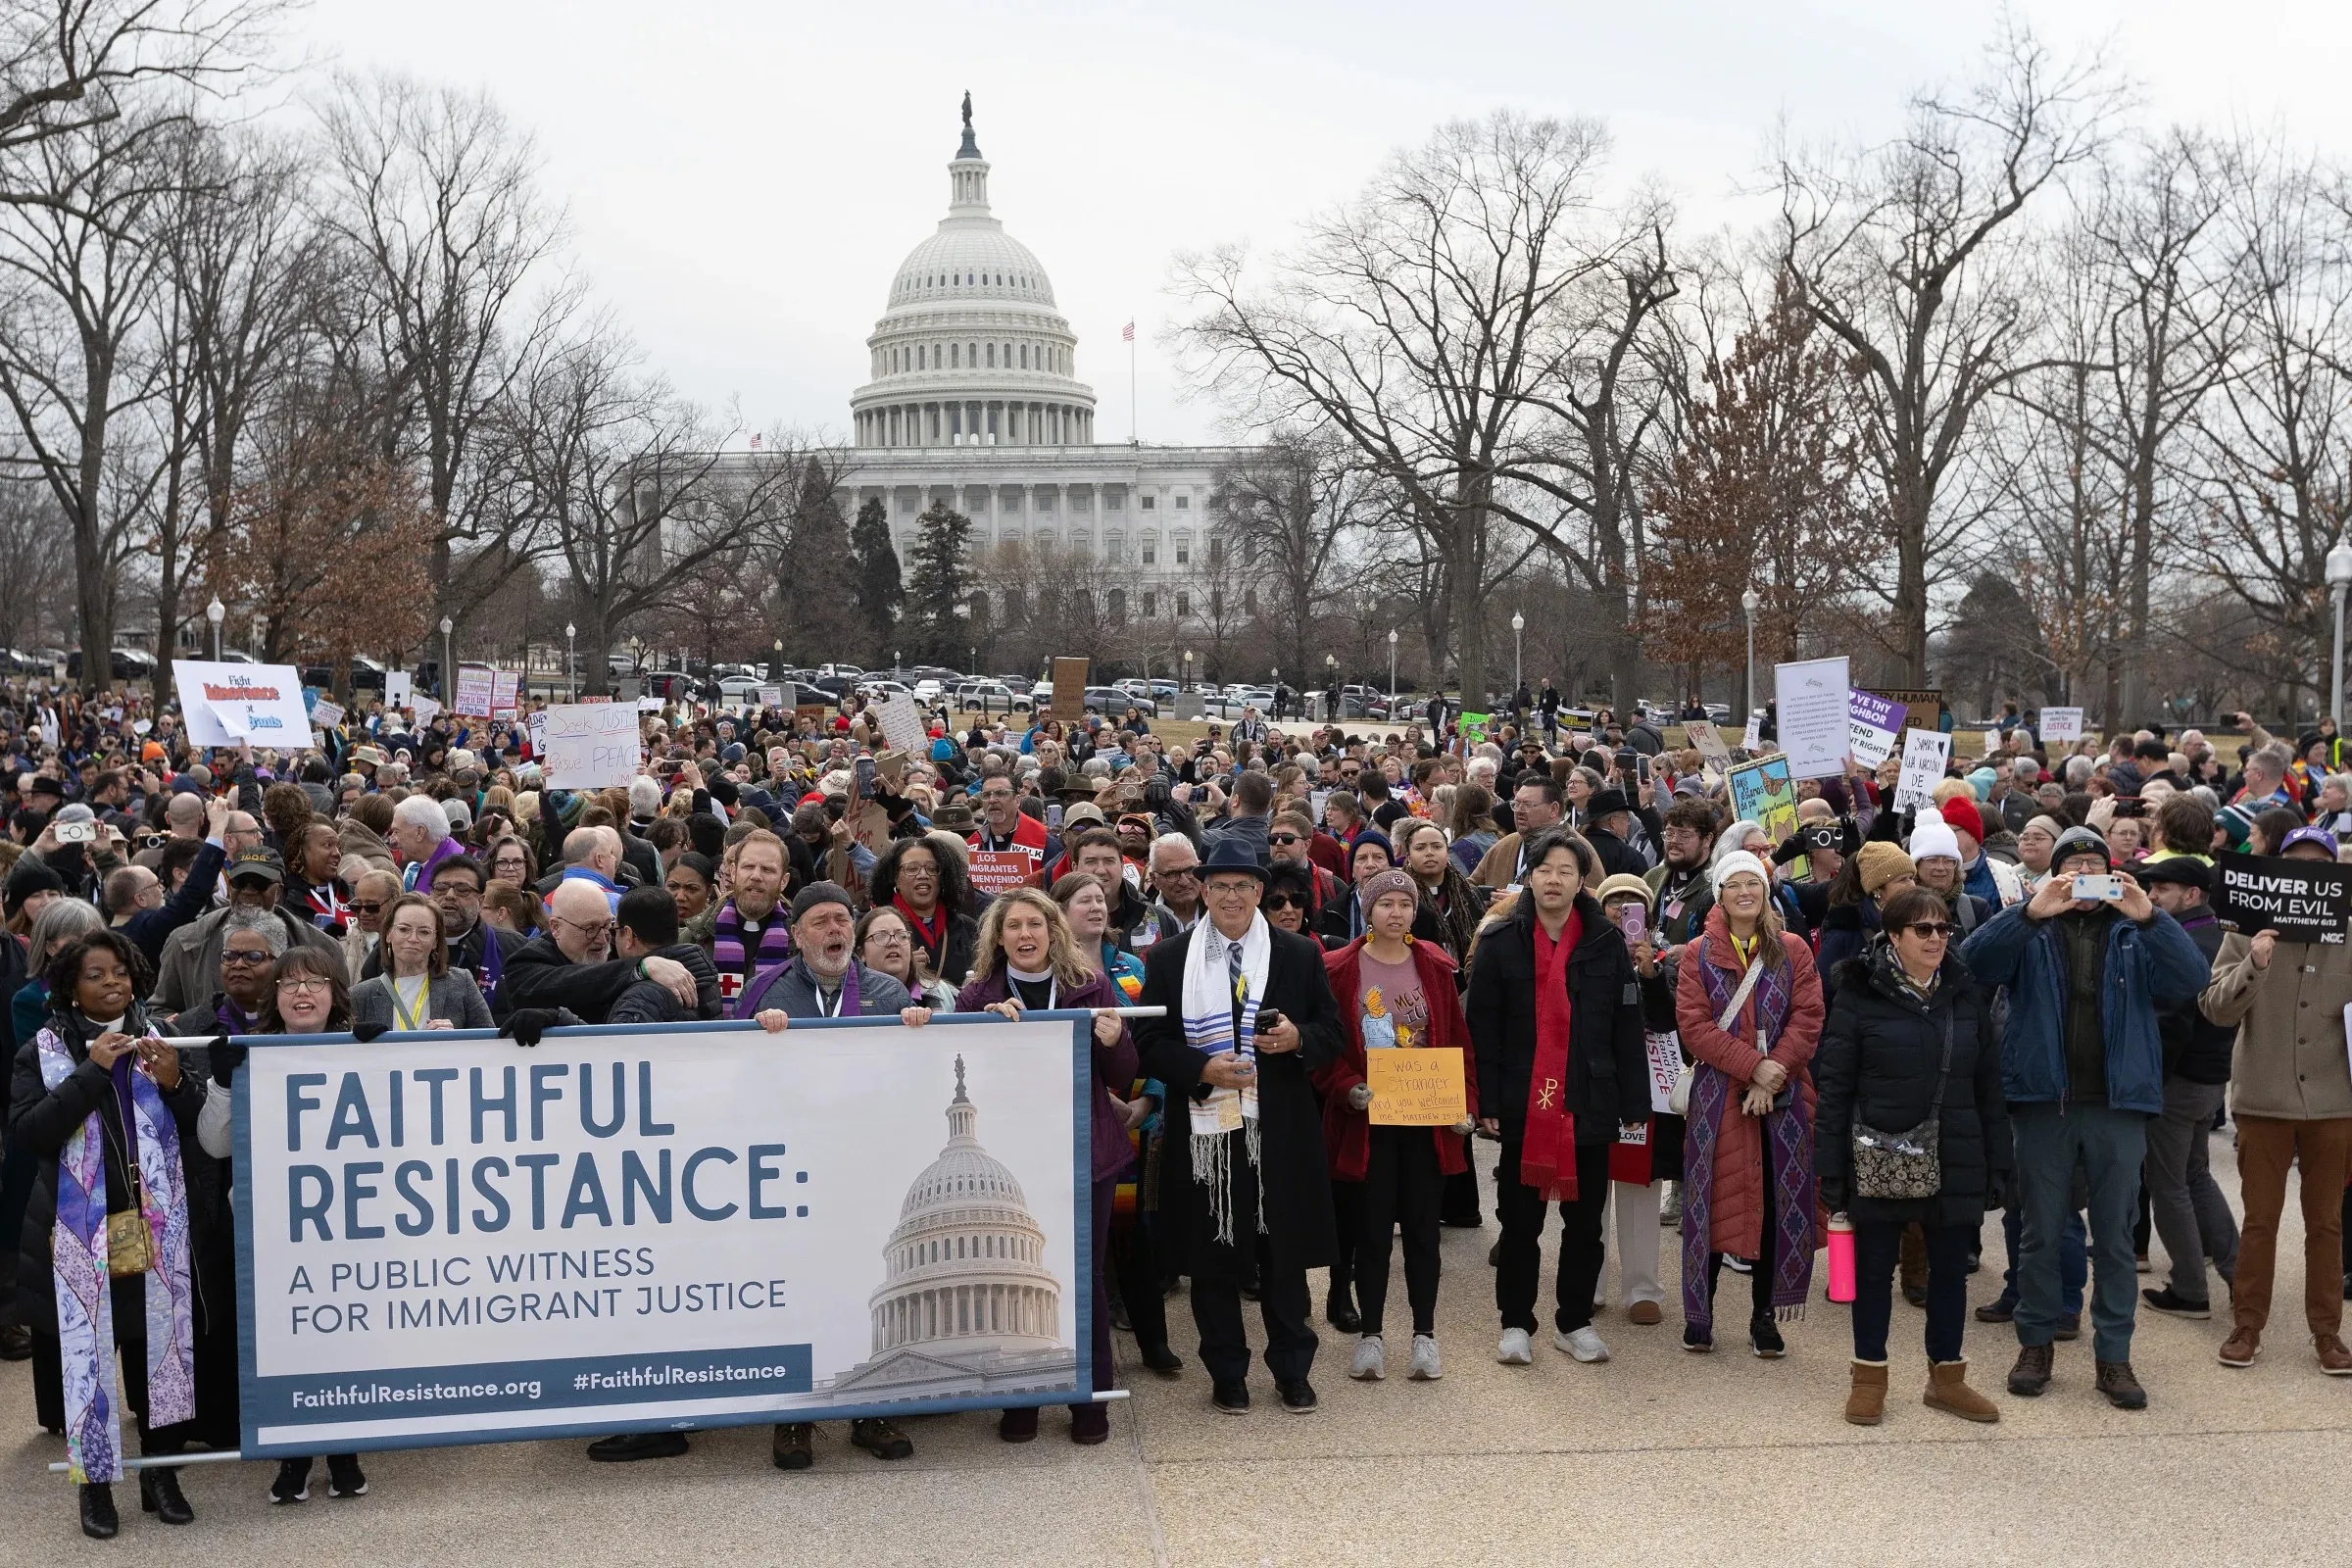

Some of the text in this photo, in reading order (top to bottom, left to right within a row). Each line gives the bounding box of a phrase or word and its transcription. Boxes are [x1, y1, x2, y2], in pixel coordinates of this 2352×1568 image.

[228, 675, 252, 687] Fight
[203, 682, 281, 701] Ignorance
[458, 694, 469, 703] love
[476, 695, 486, 704] the
[1897, 693, 1939, 704] HUMAN
[465, 705, 473, 714] the
[1872, 699, 1891, 713] THY
[529, 712, 544, 725] LOVE
[550, 707, 638, 735] Seek JUSTICE
[1849, 704, 1886, 725] GHBOR
[2045, 721, 2073, 731] JUSTICE
[1858, 740, 1888, 756] RIGHTS
[549, 753, 583, 771] Pursue
[593, 745, 639, 772] PEACE
[1912, 773, 1924, 788] DE
[1740, 801, 1748, 811] de
[977, 854, 997, 863] ¡LOS
[968, 864, 1018, 873] MIGRANTES
[971, 874, 1027, 884] BIENVENIDO
[2225, 869, 2342, 897] DELIVER US
[2229, 890, 2333, 916] FROM EVIL
[2274, 916, 2337, 927] MATTHEW 6:13
[1394, 986, 1425, 1011] MELT
[1393, 1059, 1422, 1073] was
[1430, 1060, 1440, 1073] a
[1645, 1030, 1671, 1095] USTICE
[1386, 1076, 1450, 1099] Stranger
[287, 1061, 675, 1152] FAITHFUL
[1372, 1095, 1460, 1111] and you welcomed
[1403, 1112, 1439, 1122] MATTHEW
[1442, 1111, 1466, 1121] 25:35
[289, 1144, 809, 1244] RESISTANCE:
[288, 1247, 655, 1295] A PUBLIC WITNESS
[291, 1279, 786, 1335] FOR IMMIGRANT JUSTICE
[573, 1364, 786, 1391] #FaithfulResistance
[292, 1380, 541, 1409] FaithfulResistance.org
